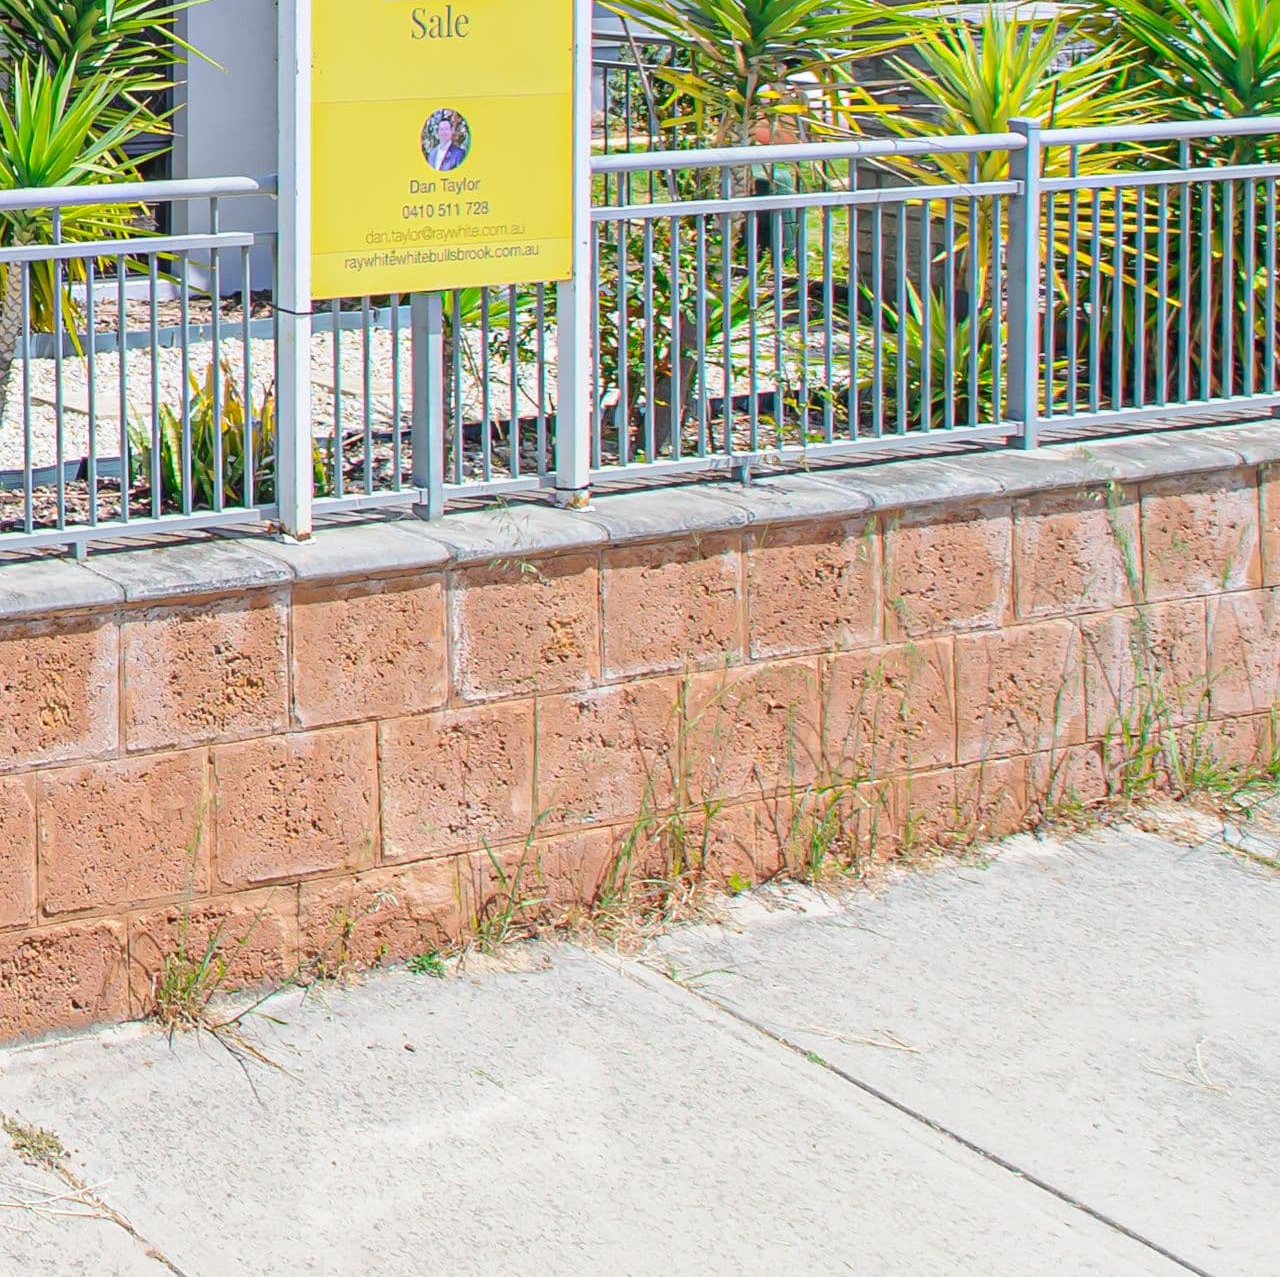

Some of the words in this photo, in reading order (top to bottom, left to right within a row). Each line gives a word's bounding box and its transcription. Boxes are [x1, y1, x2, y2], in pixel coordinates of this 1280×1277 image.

[410, 3, 470, 40] Sale
[409, 179, 436, 194] Dan
[440, 176, 481, 195] Taylor
[402, 203, 434, 219] 0410
[438, 202, 460, 218] 511
[465, 200, 489, 215] 728
[365, 224, 525, 245] dan.taylor@raywhite.com.au
